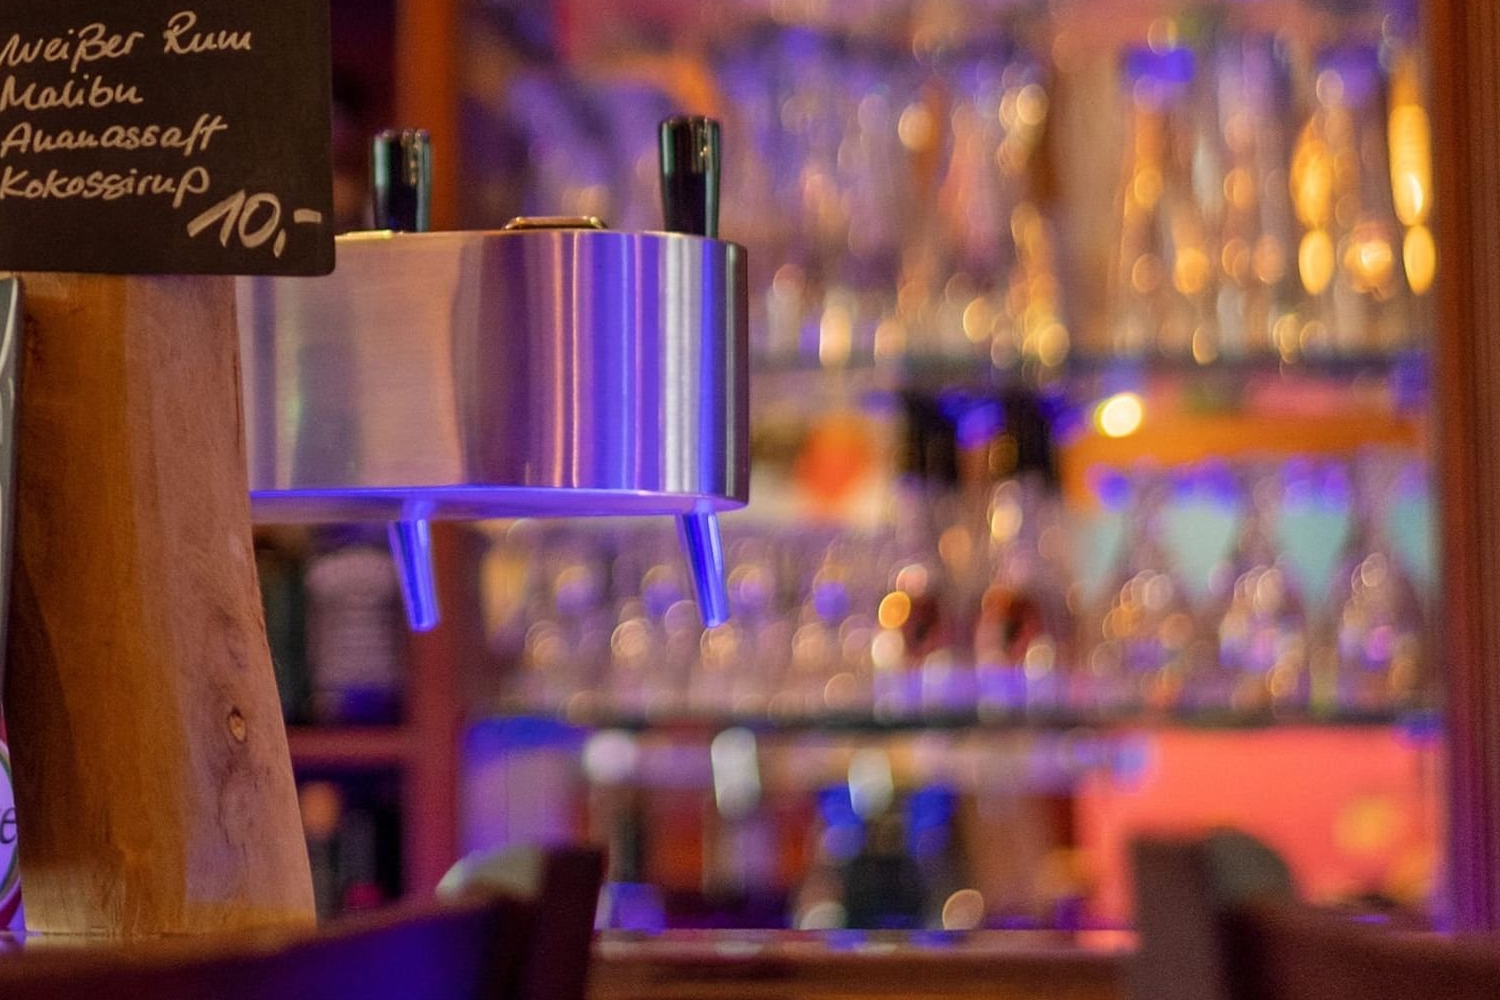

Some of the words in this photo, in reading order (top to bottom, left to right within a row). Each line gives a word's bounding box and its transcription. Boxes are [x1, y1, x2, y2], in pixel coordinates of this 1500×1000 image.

[162, 10, 252, 56] Rum
[0, 73, 145, 112] Malibu
[0, 113, 229, 158] Ananassaft
[0, 165, 210, 209] Kokossirup
